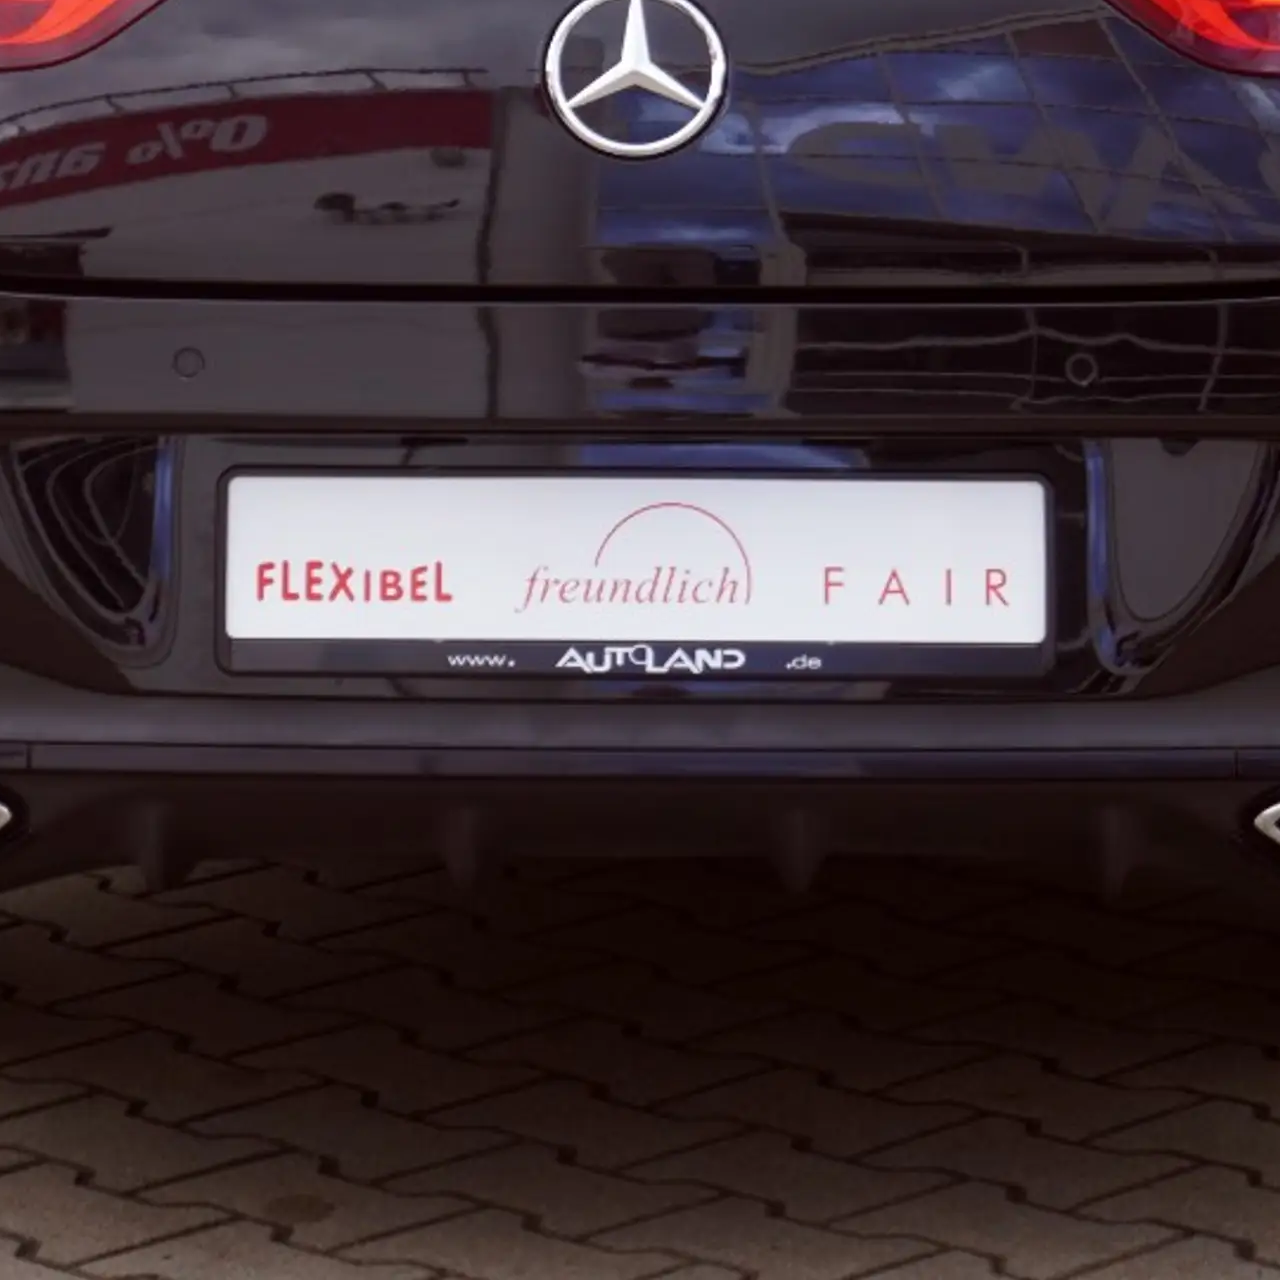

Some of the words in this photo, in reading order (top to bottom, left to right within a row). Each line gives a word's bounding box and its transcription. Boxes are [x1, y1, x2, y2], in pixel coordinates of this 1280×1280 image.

[256, 559, 454, 604] FLEXIBEL
[514, 565, 740, 614] freundlich
[823, 566, 1011, 607] FAIR
[446, 653, 517, 668] www.
[555, 644, 747, 674] AUTOLAND
[785, 652, 822, 670] .de
